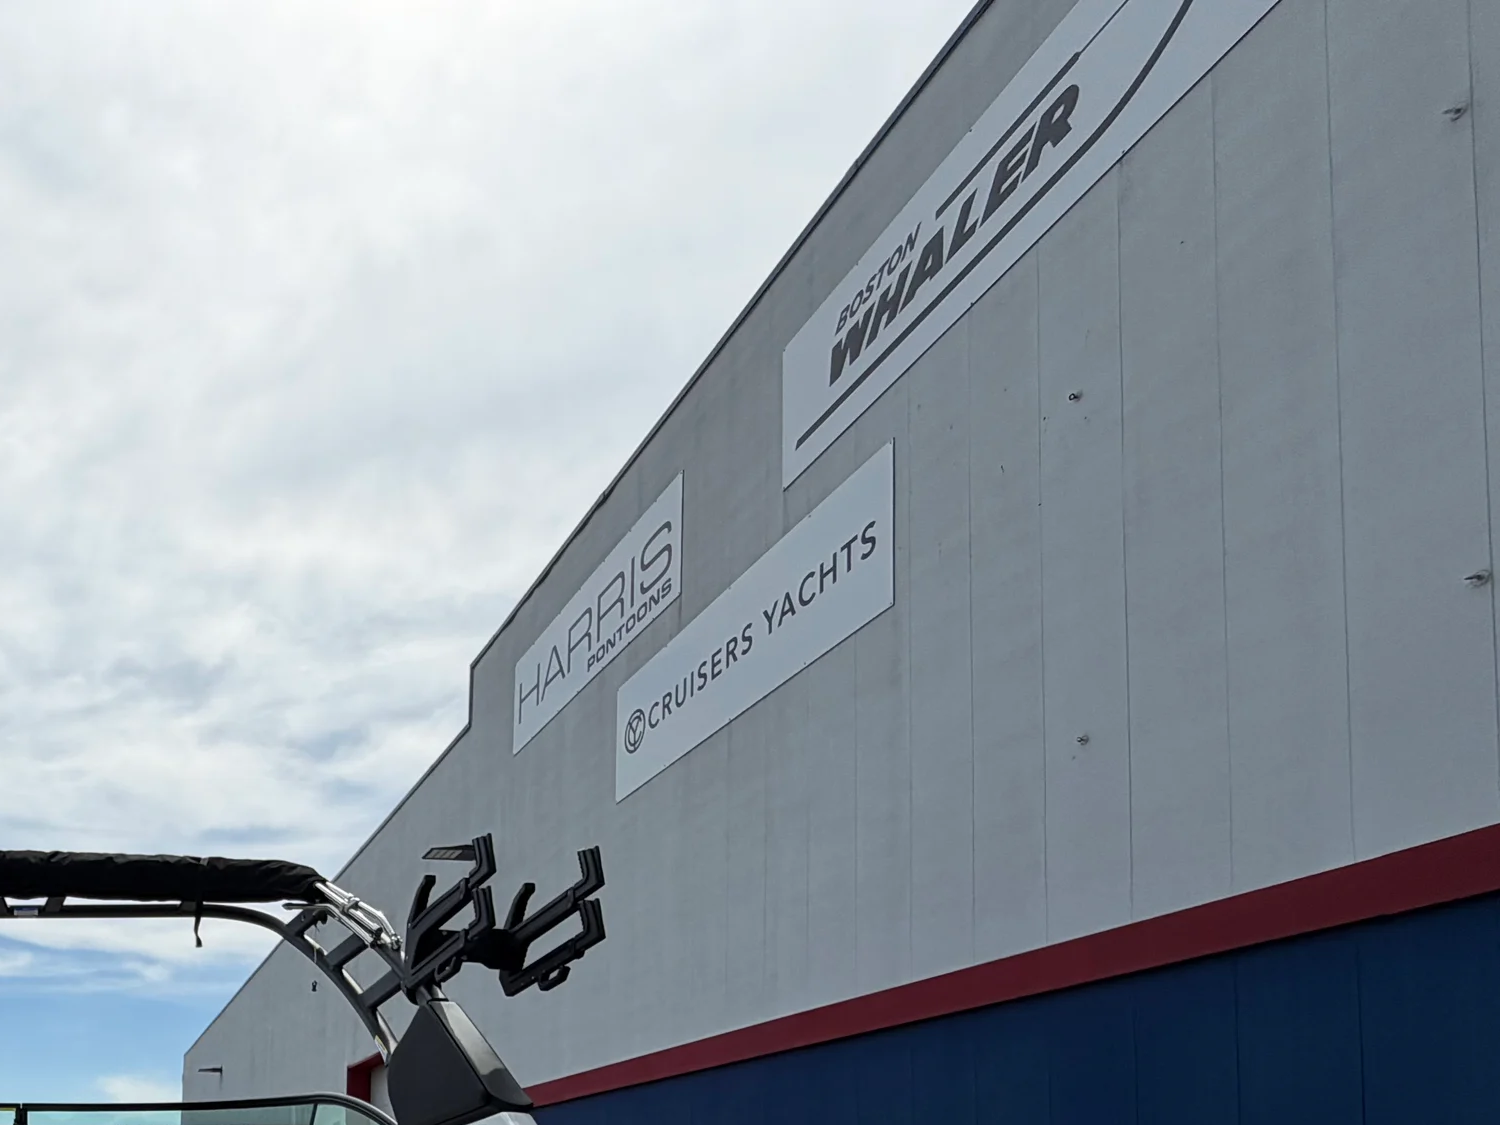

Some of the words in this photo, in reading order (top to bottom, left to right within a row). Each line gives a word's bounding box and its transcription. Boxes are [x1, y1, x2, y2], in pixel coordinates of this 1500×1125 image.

[830, 84, 1079, 386] WHALER
[835, 222, 922, 336] BOSTON
[518, 520, 673, 724] HARRIS
[587, 578, 673, 673] PONTOONS
[648, 623, 753, 729] CRUISERS
[762, 520, 877, 635] YACHTS
